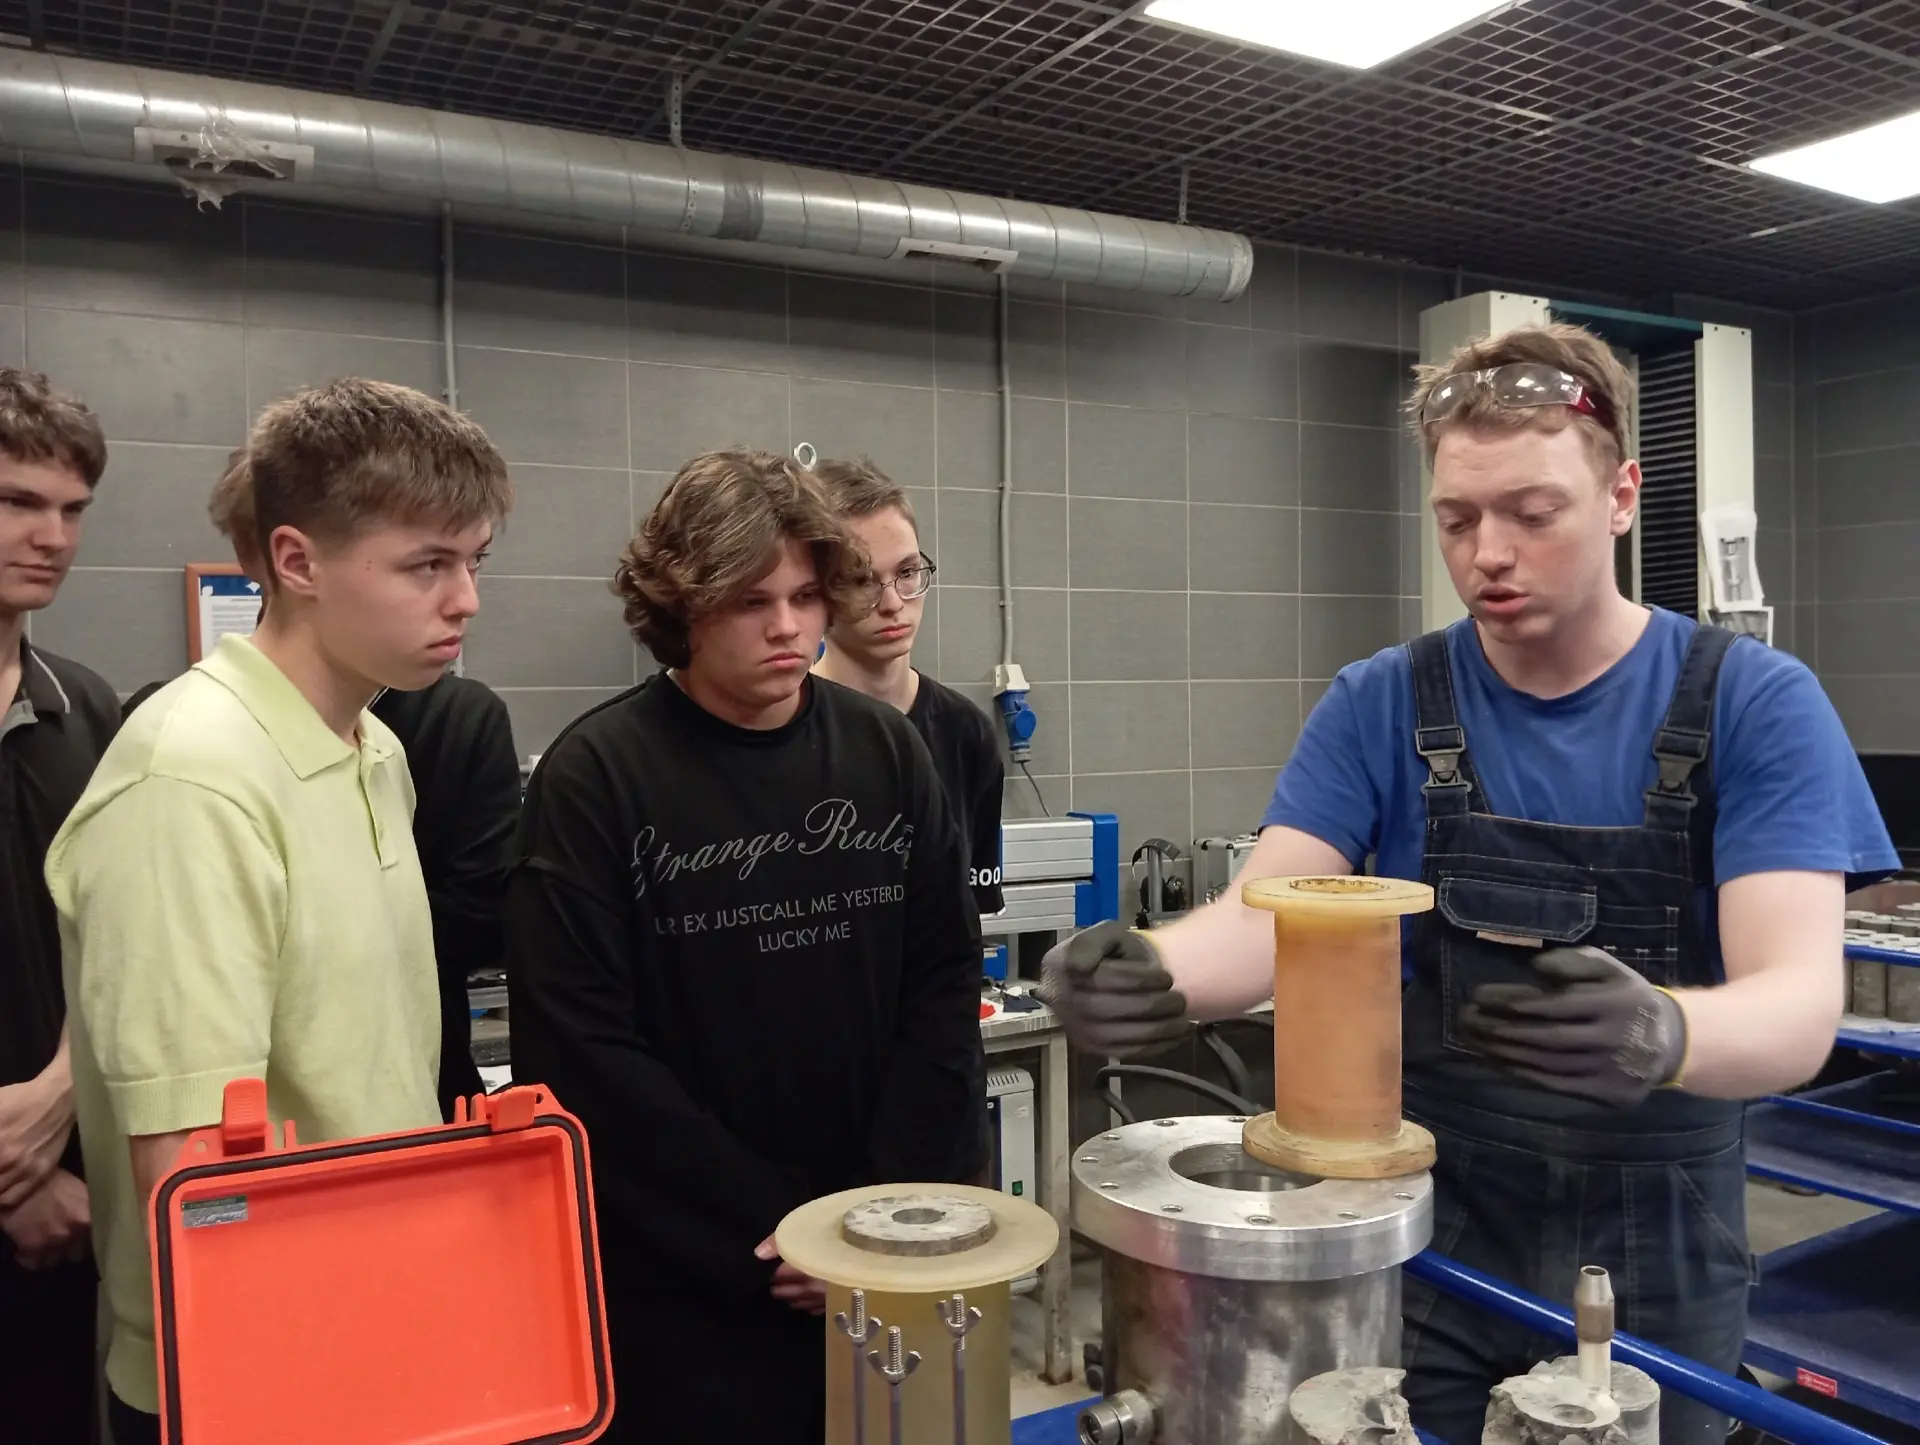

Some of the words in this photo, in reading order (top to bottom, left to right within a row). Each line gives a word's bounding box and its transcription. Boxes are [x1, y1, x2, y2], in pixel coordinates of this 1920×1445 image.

[630, 824, 794, 901] Strange
[683, 912, 708, 934] EX
[713, 899, 806, 930] JUSTCALL
[811, 893, 838, 915] ME
[842, 884, 904, 909] YESTERD
[758, 926, 820, 953] LUCKY
[825, 920, 852, 943] ME
